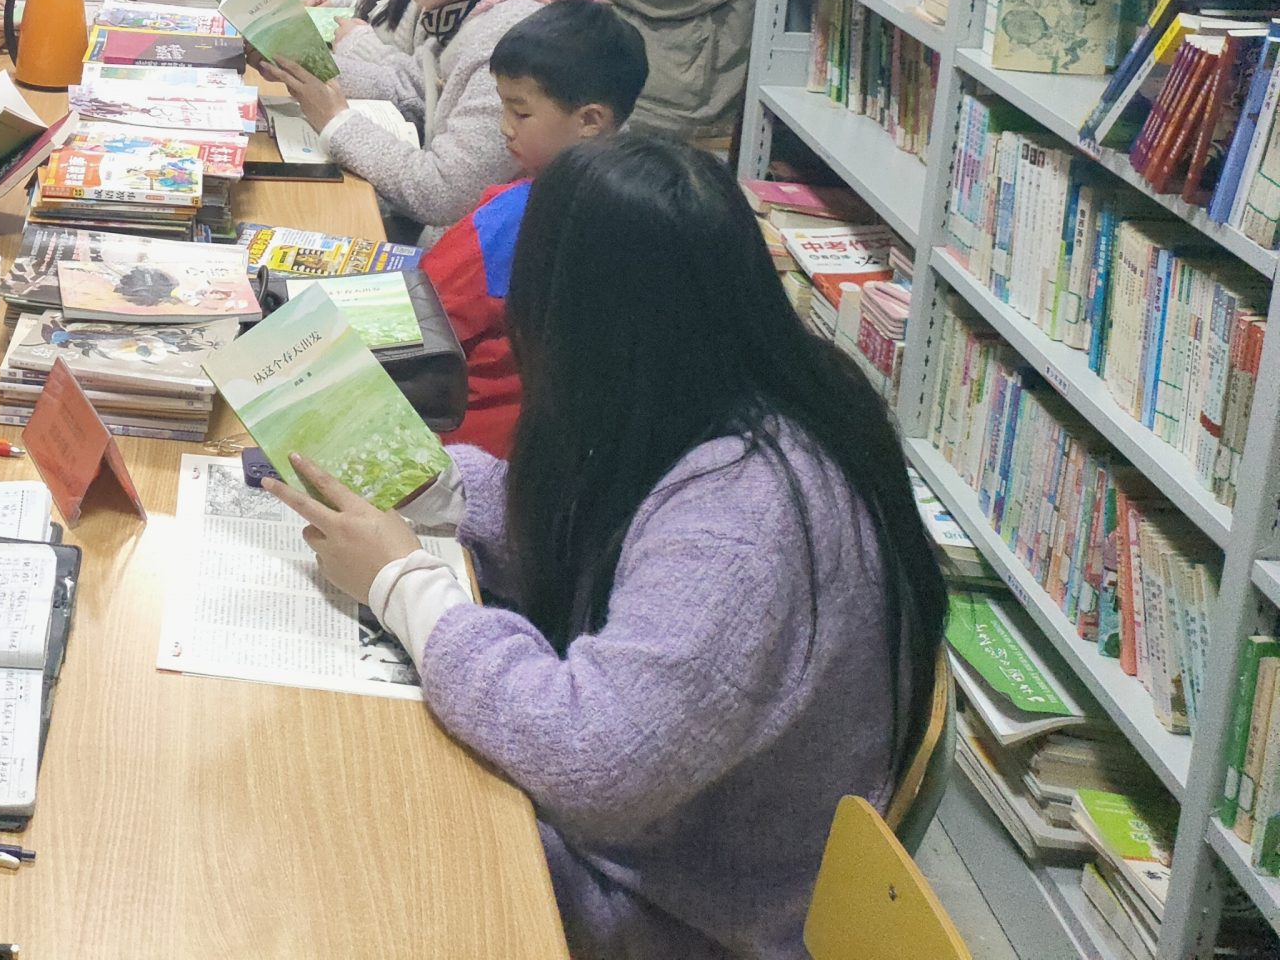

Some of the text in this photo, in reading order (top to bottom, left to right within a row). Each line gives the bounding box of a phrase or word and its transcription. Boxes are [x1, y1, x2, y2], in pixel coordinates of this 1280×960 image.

[253, 330, 322, 384] 从这个春天出发
